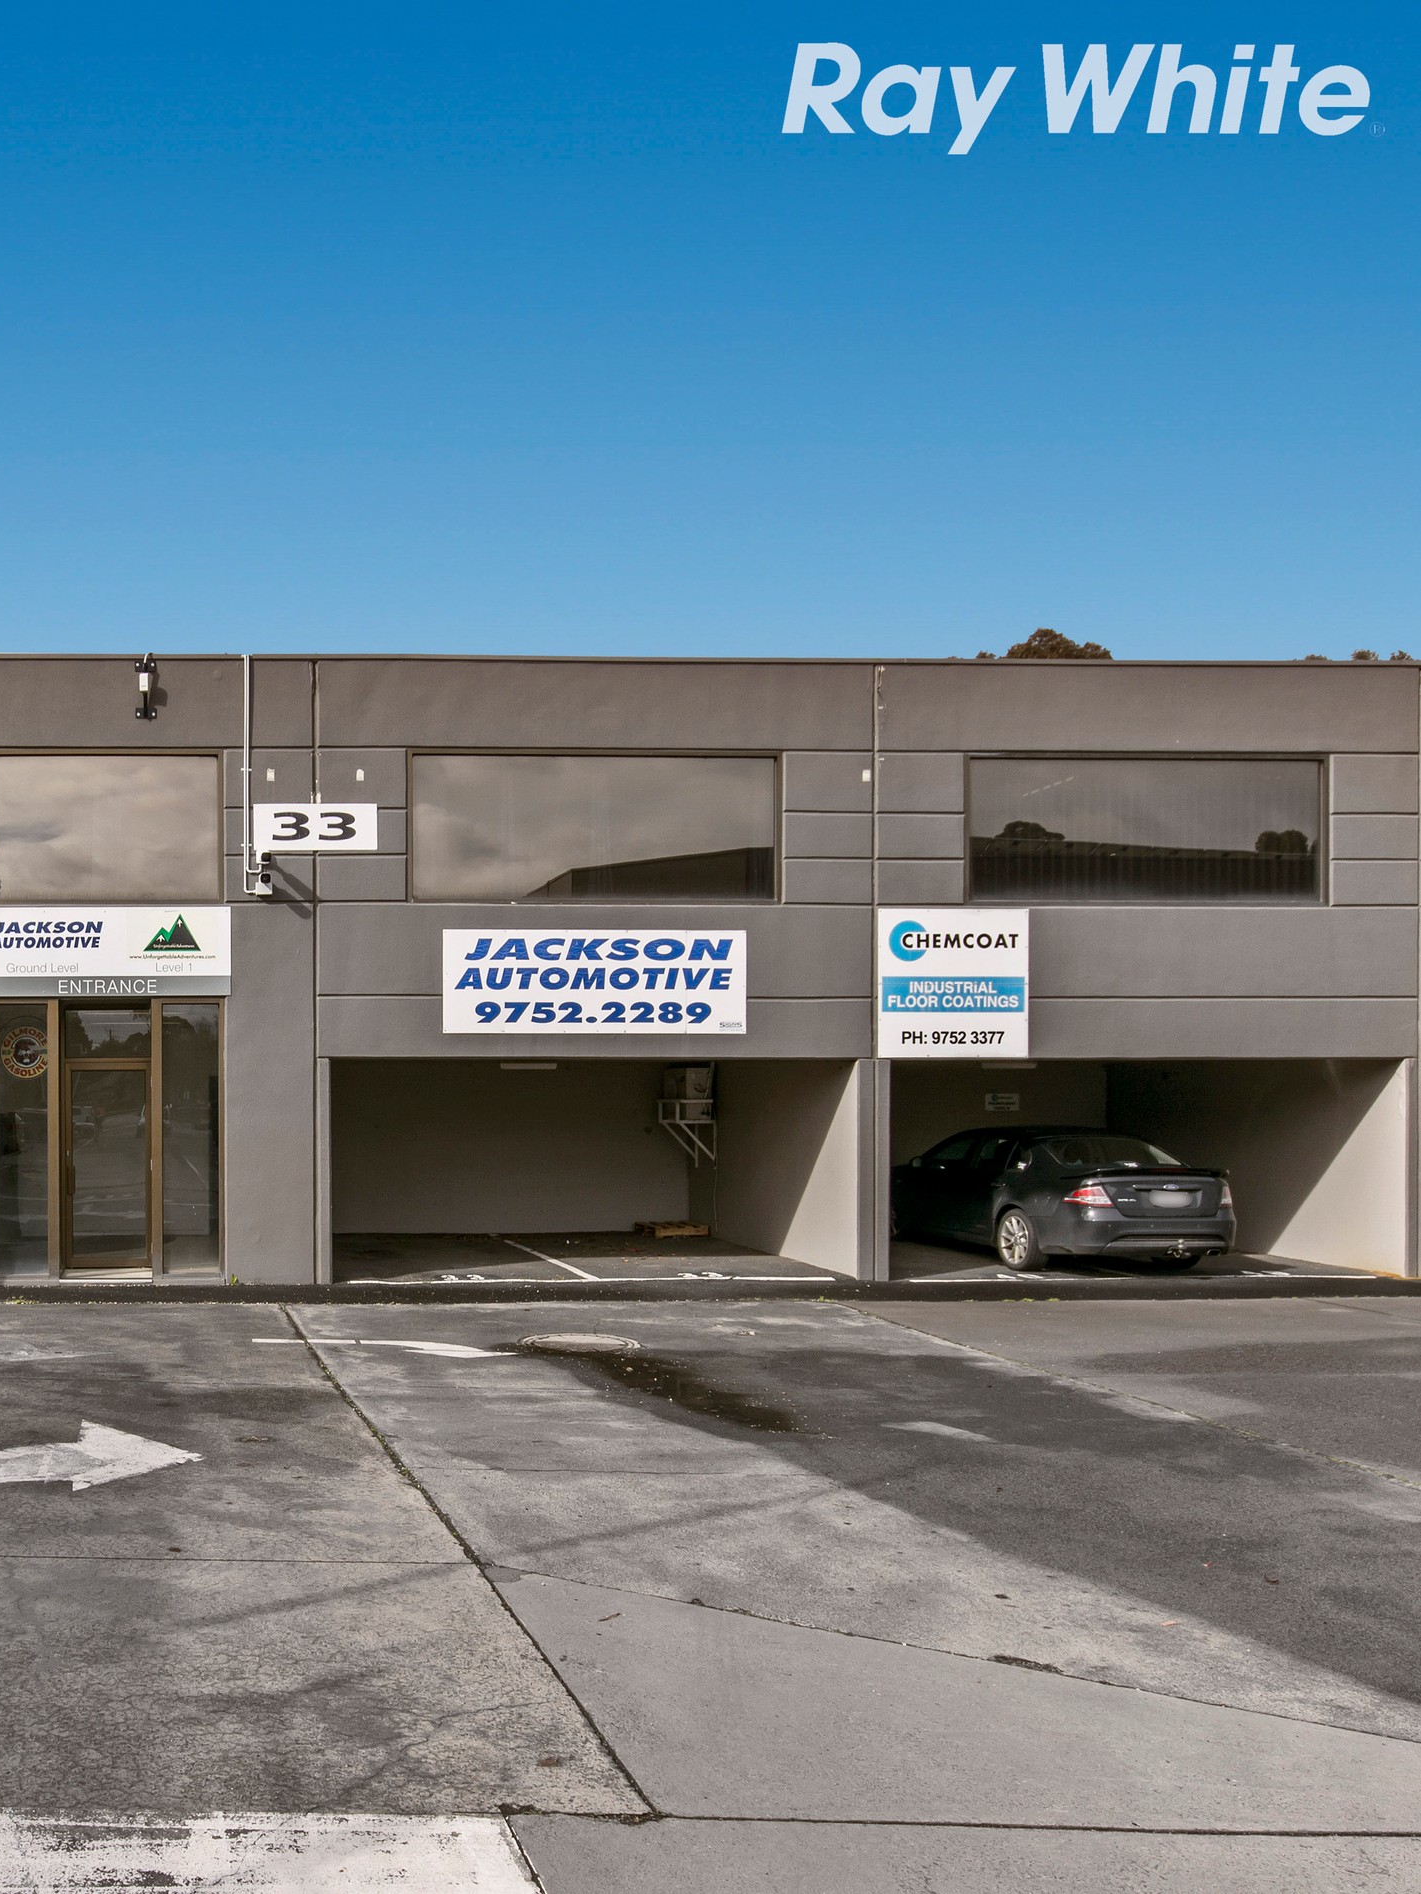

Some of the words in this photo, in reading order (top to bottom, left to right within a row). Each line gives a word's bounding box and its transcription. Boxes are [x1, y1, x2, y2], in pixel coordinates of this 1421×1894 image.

[272, 811, 357, 841] 33
[901, 933, 1019, 949] CHEMCOAT
[464, 938, 734, 961] JACKSON
[6, 962, 47, 974] Ground
[50, 962, 79, 973] Level
[155, 962, 184, 973] Level
[187, 962, 193, 973] 1
[58, 979, 157, 994] ENTRANCE
[454, 967, 733, 991] AUTOMOTIVE
[887, 995, 938, 1008] FLOOR
[942, 995, 1019, 1008] COATINGS
[474, 1001, 712, 1024] 9752.2289
[901, 1030, 928, 1045] PH:
[931, 1030, 967, 1045] 9752
[970, 1030, 1005, 1045] 3377
[3, 1057, 48, 1077] GASOLINE
